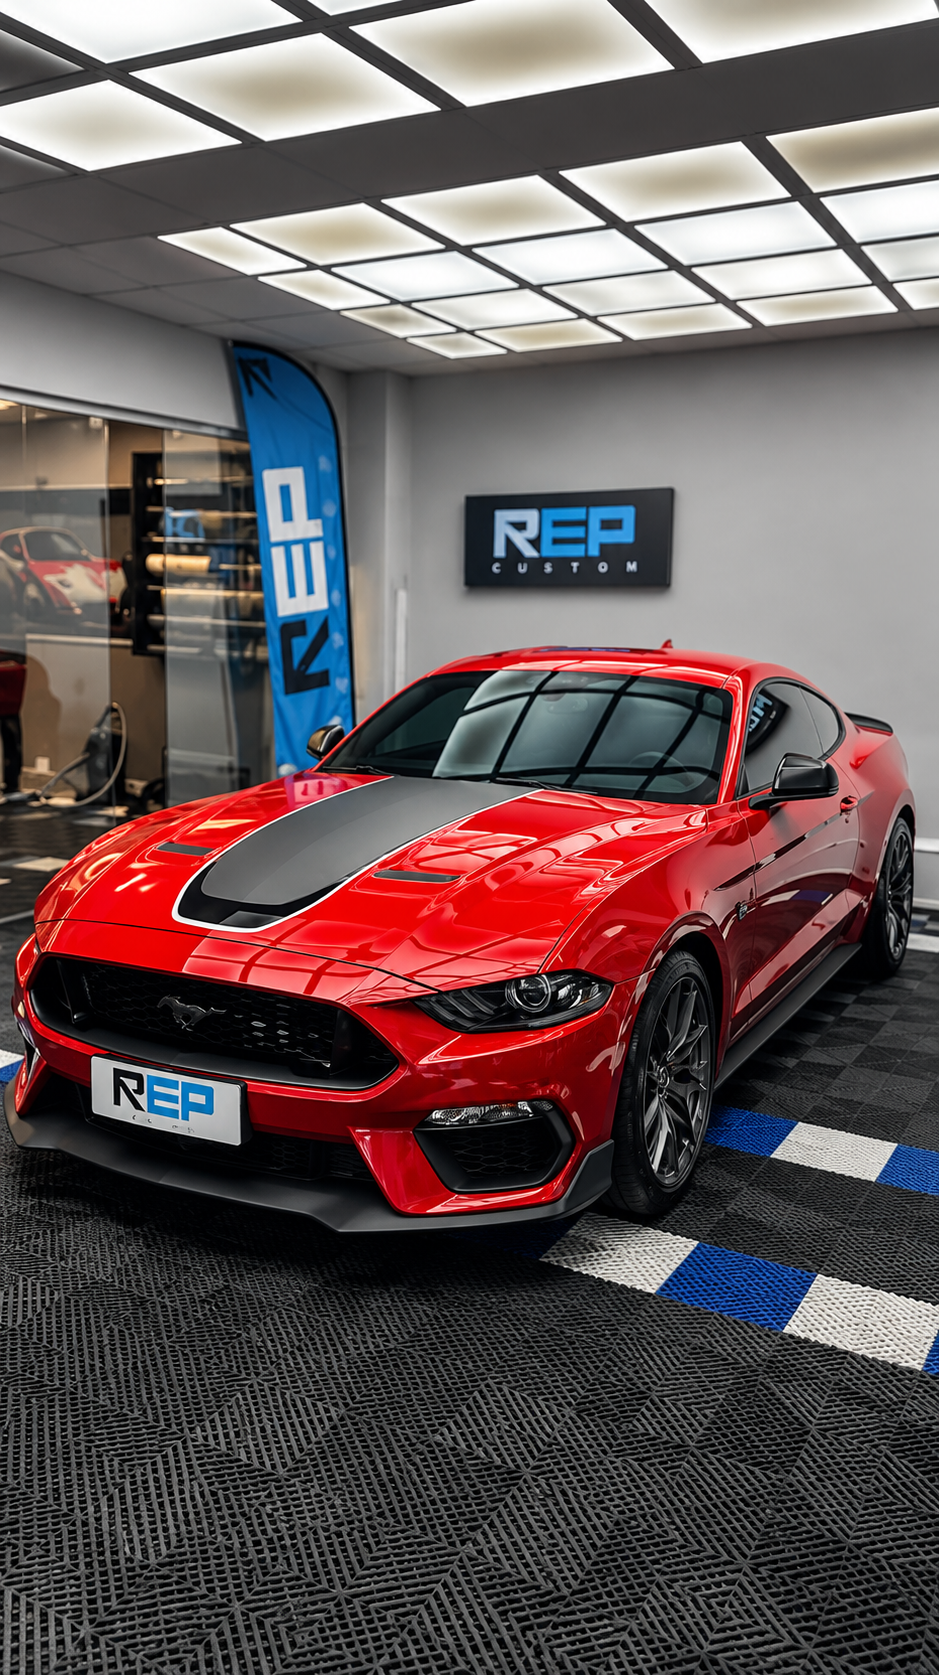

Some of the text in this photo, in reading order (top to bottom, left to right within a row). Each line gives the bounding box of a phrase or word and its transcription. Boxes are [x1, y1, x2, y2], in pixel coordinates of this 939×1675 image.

[493, 505, 636, 558] REP
[262, 466, 331, 695] REP
[491, 561, 638, 574] CUSTOM
[113, 1067, 214, 1121] REP
